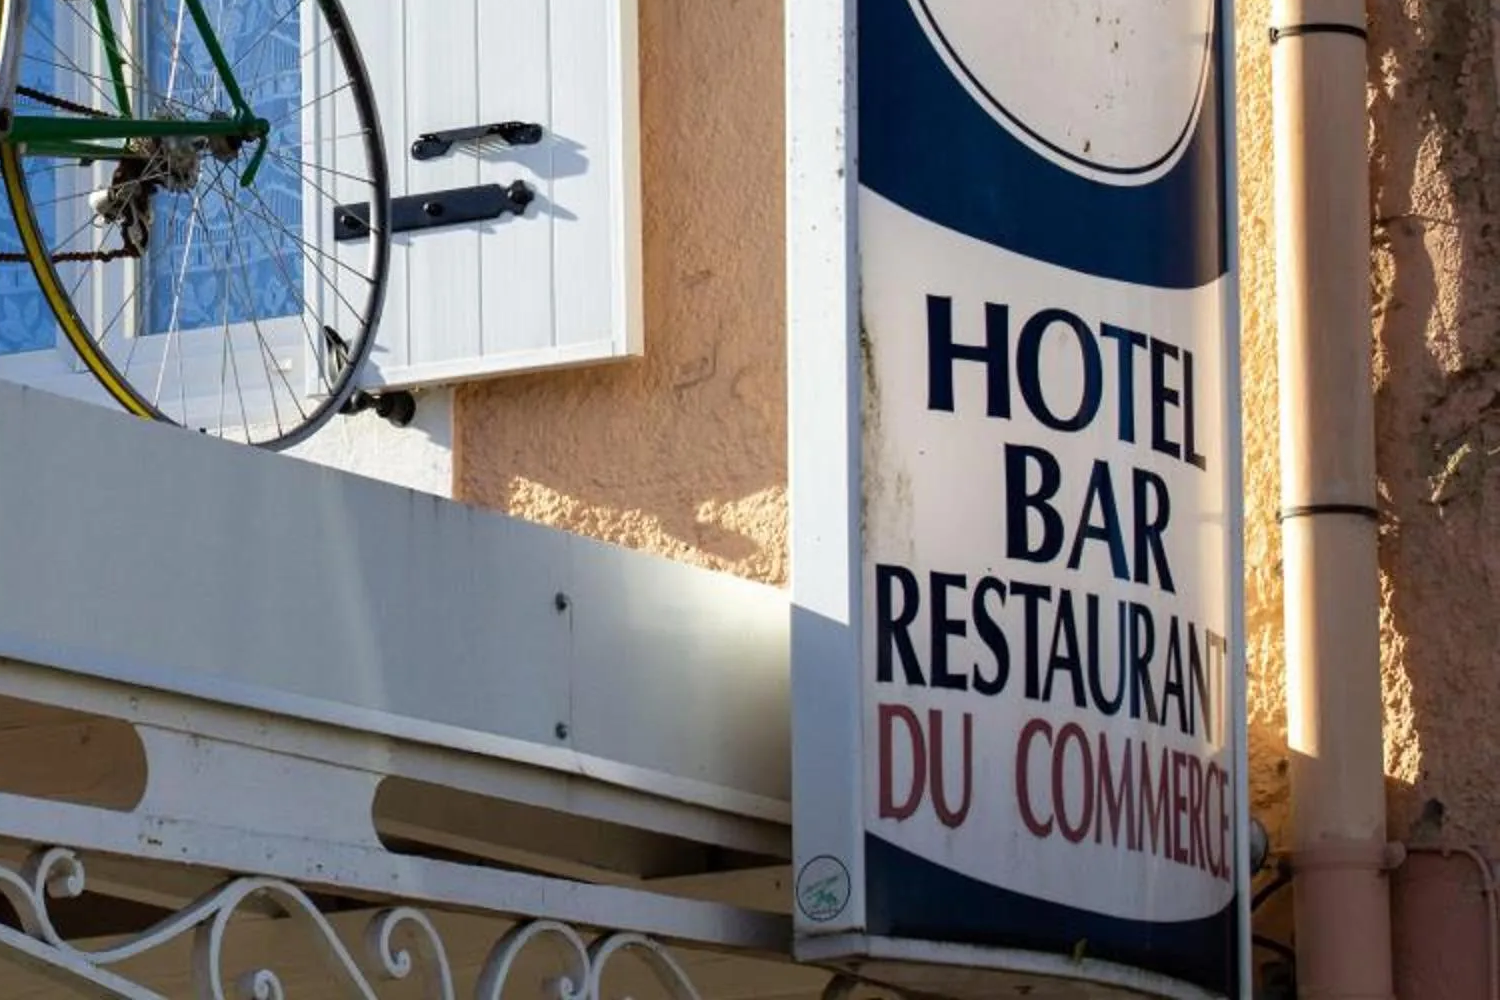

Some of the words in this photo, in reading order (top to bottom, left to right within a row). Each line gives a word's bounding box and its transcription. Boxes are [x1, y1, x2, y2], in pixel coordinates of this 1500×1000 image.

[926, 294, 1206, 472] HOTEL
[1004, 442, 1176, 594] BAR
[875, 563, 1228, 745] RESTAURANT
[878, 703, 972, 829] DU
[1015, 717, 1230, 882] COMMERCE
